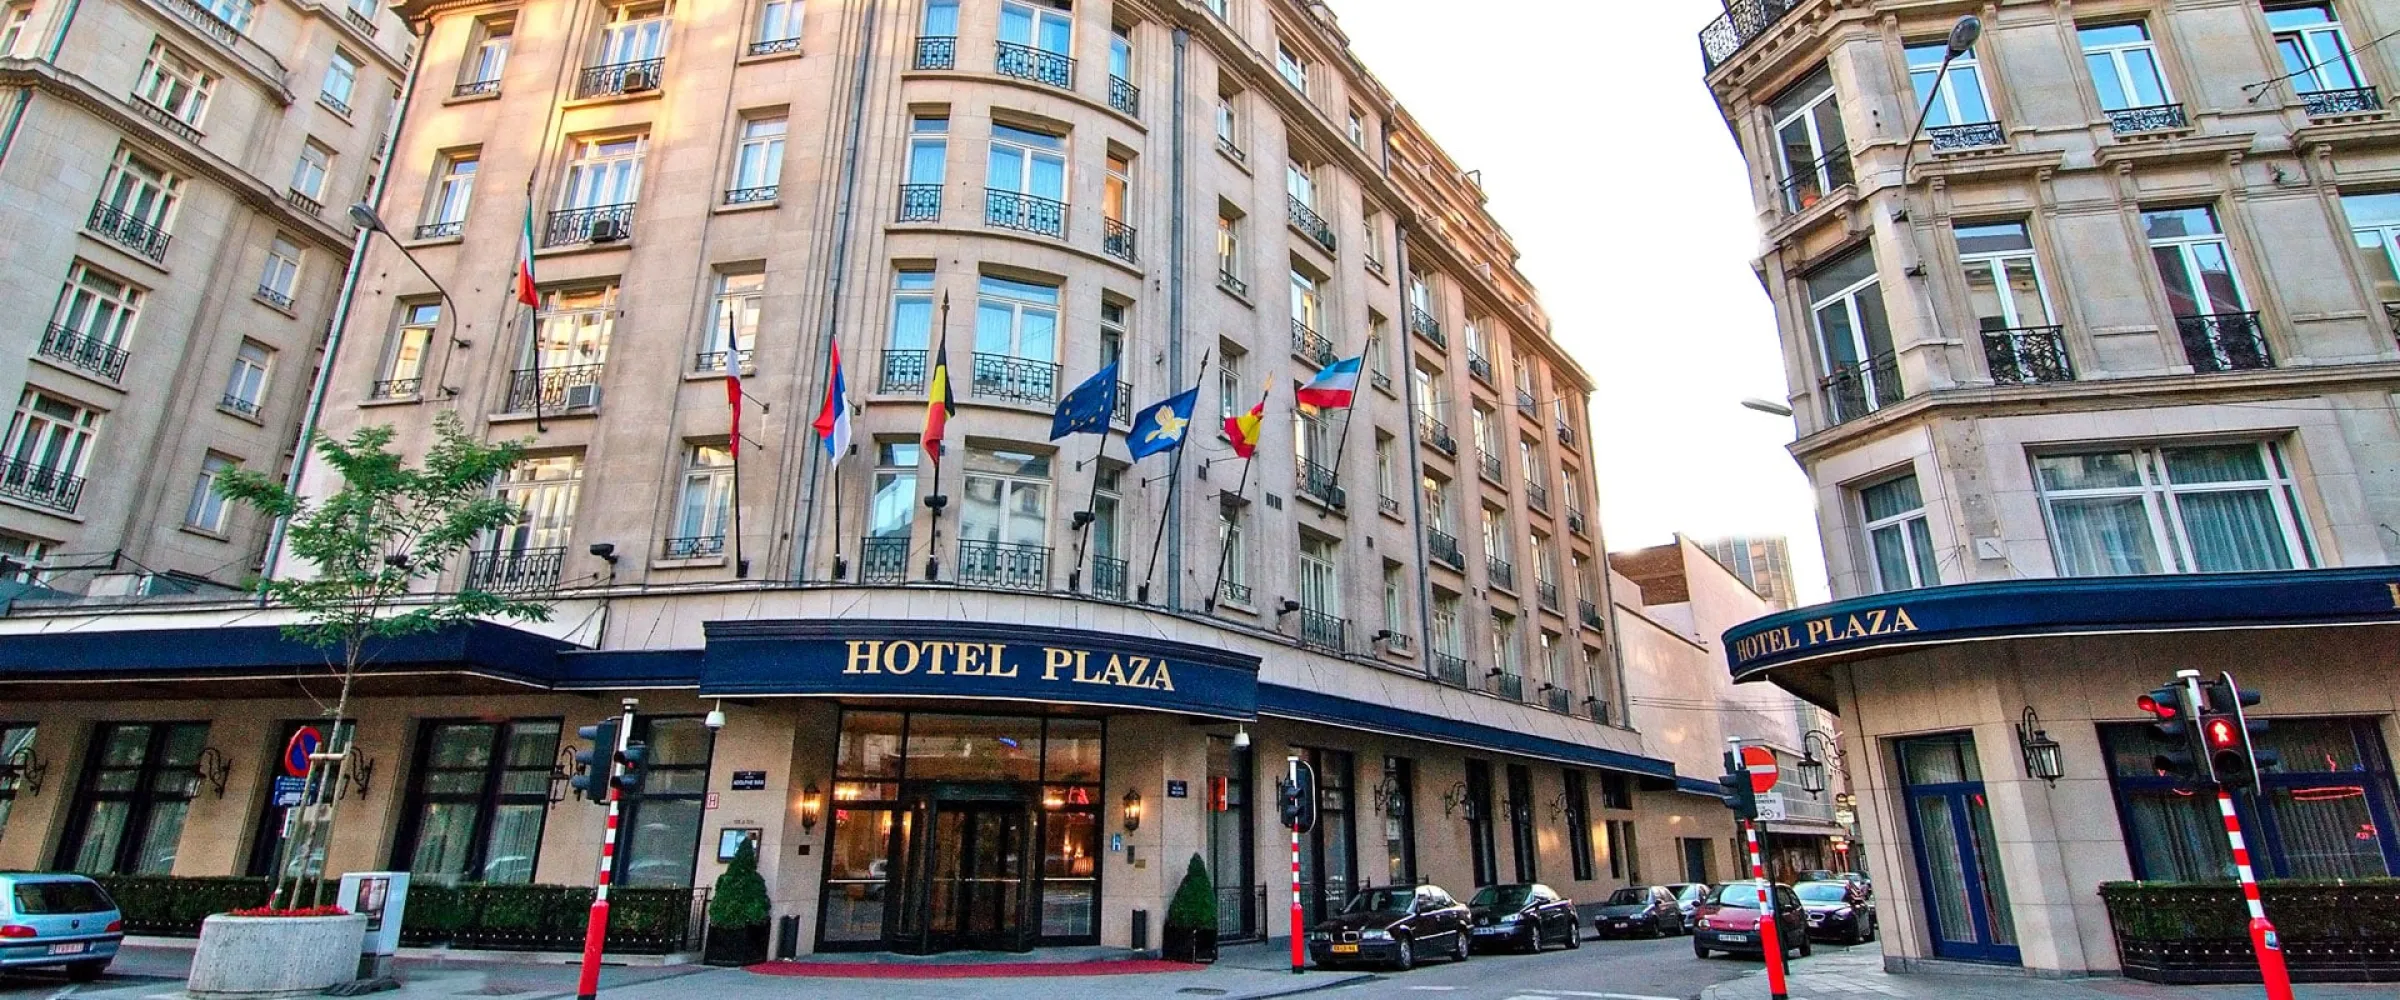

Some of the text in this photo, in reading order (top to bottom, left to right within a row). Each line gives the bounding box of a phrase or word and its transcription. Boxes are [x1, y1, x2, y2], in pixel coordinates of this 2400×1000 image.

[1736, 607, 1919, 661] HOTEL PLAZA
[843, 640, 1176, 692] HOTEL PLAZA
[709, 795, 716, 806] H
